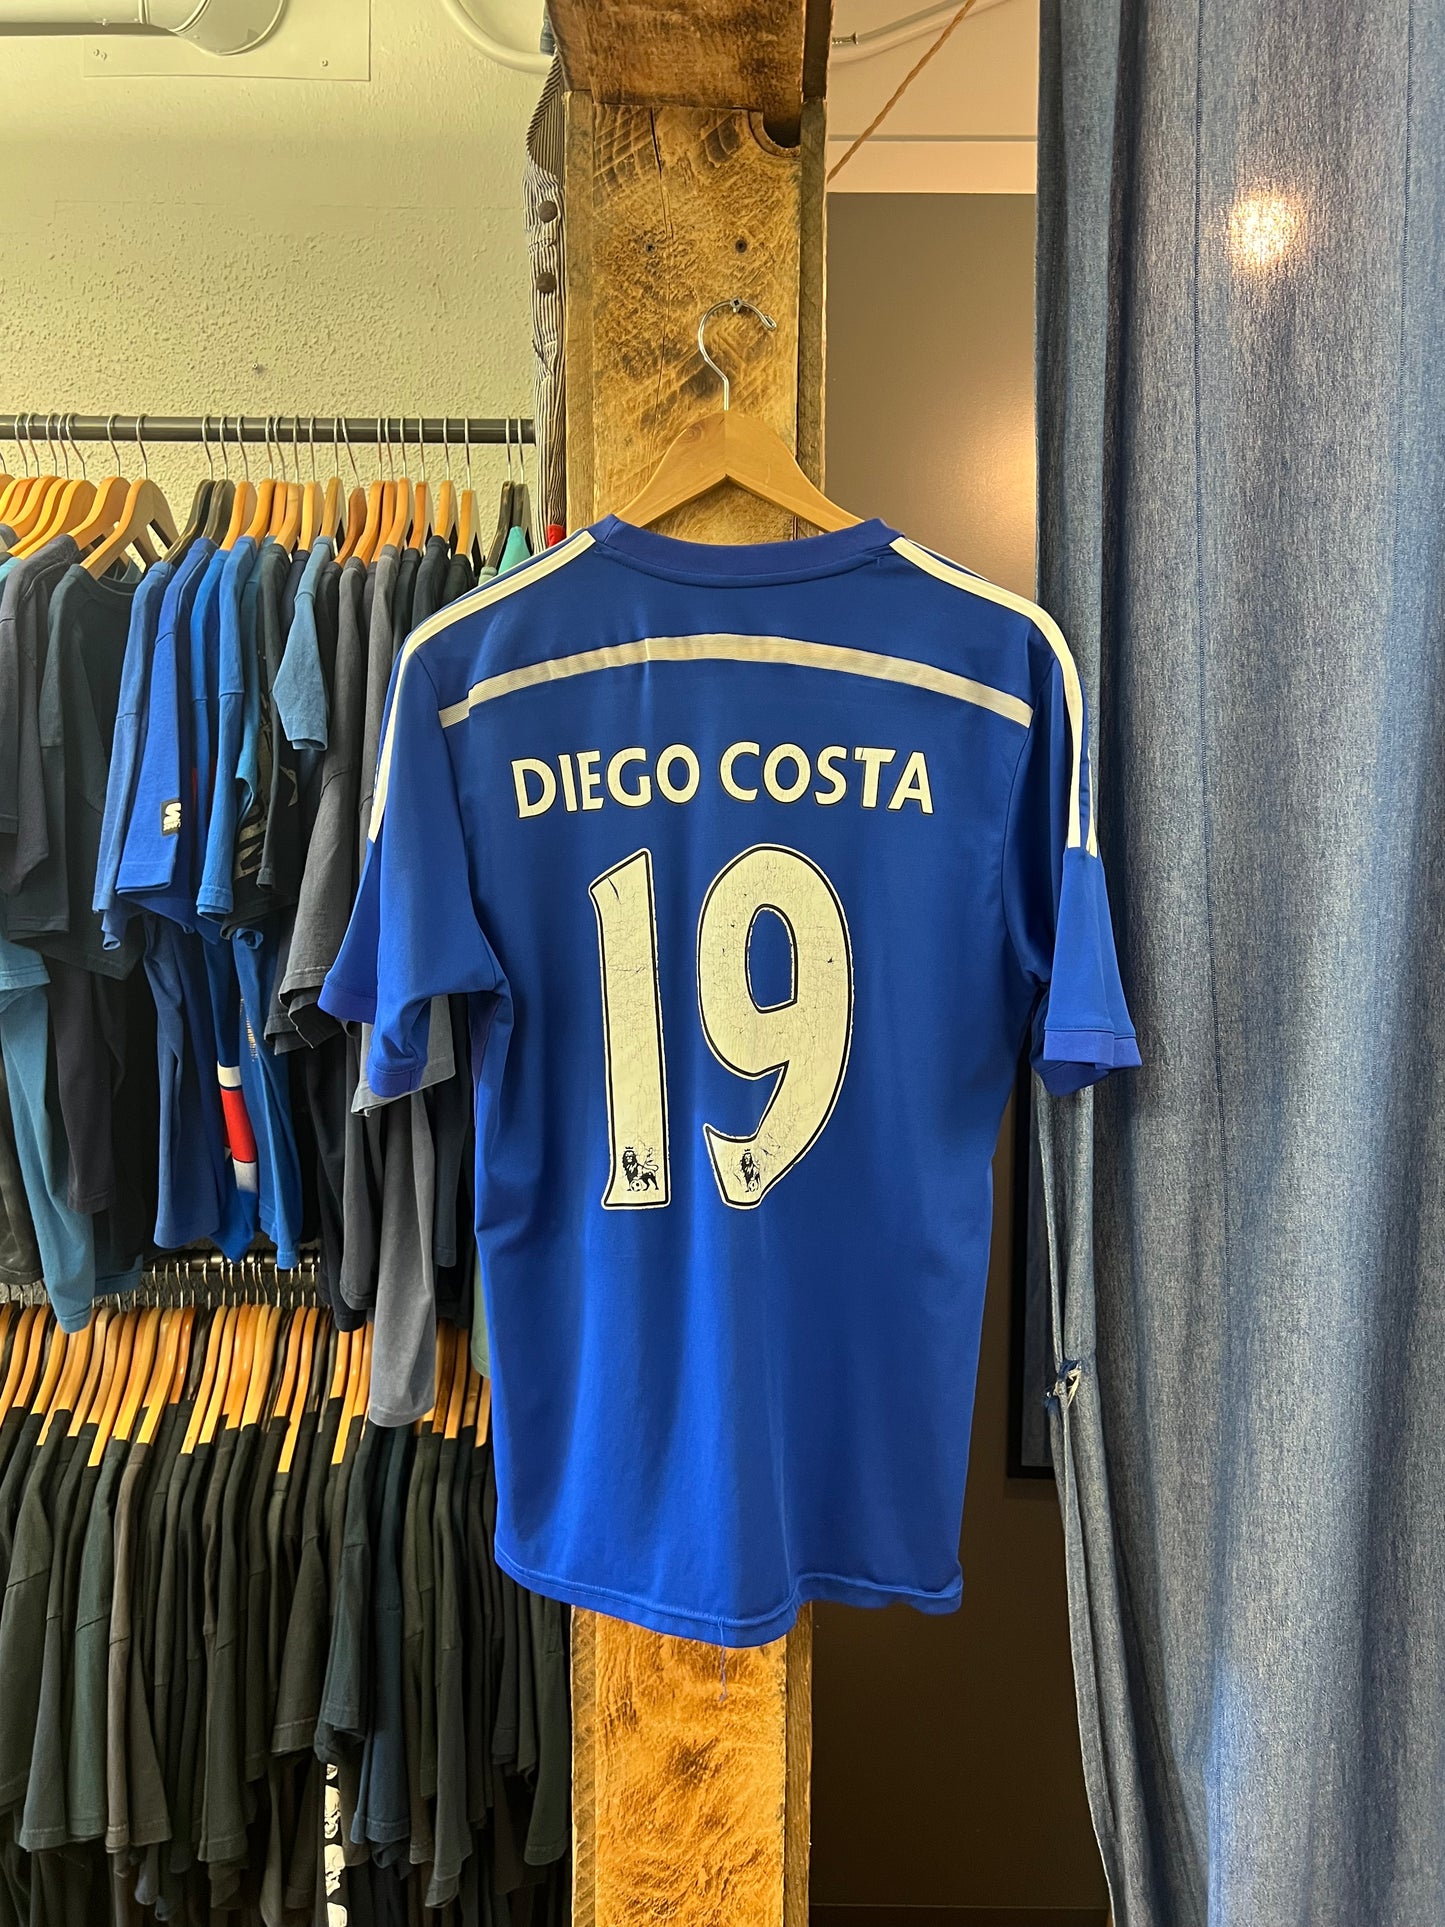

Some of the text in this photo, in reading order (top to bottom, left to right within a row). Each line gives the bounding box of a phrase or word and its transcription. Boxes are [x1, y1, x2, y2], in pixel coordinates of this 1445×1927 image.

[510, 741, 934, 819] DIEGO COSTA
[588, 843, 854, 1210] 19
